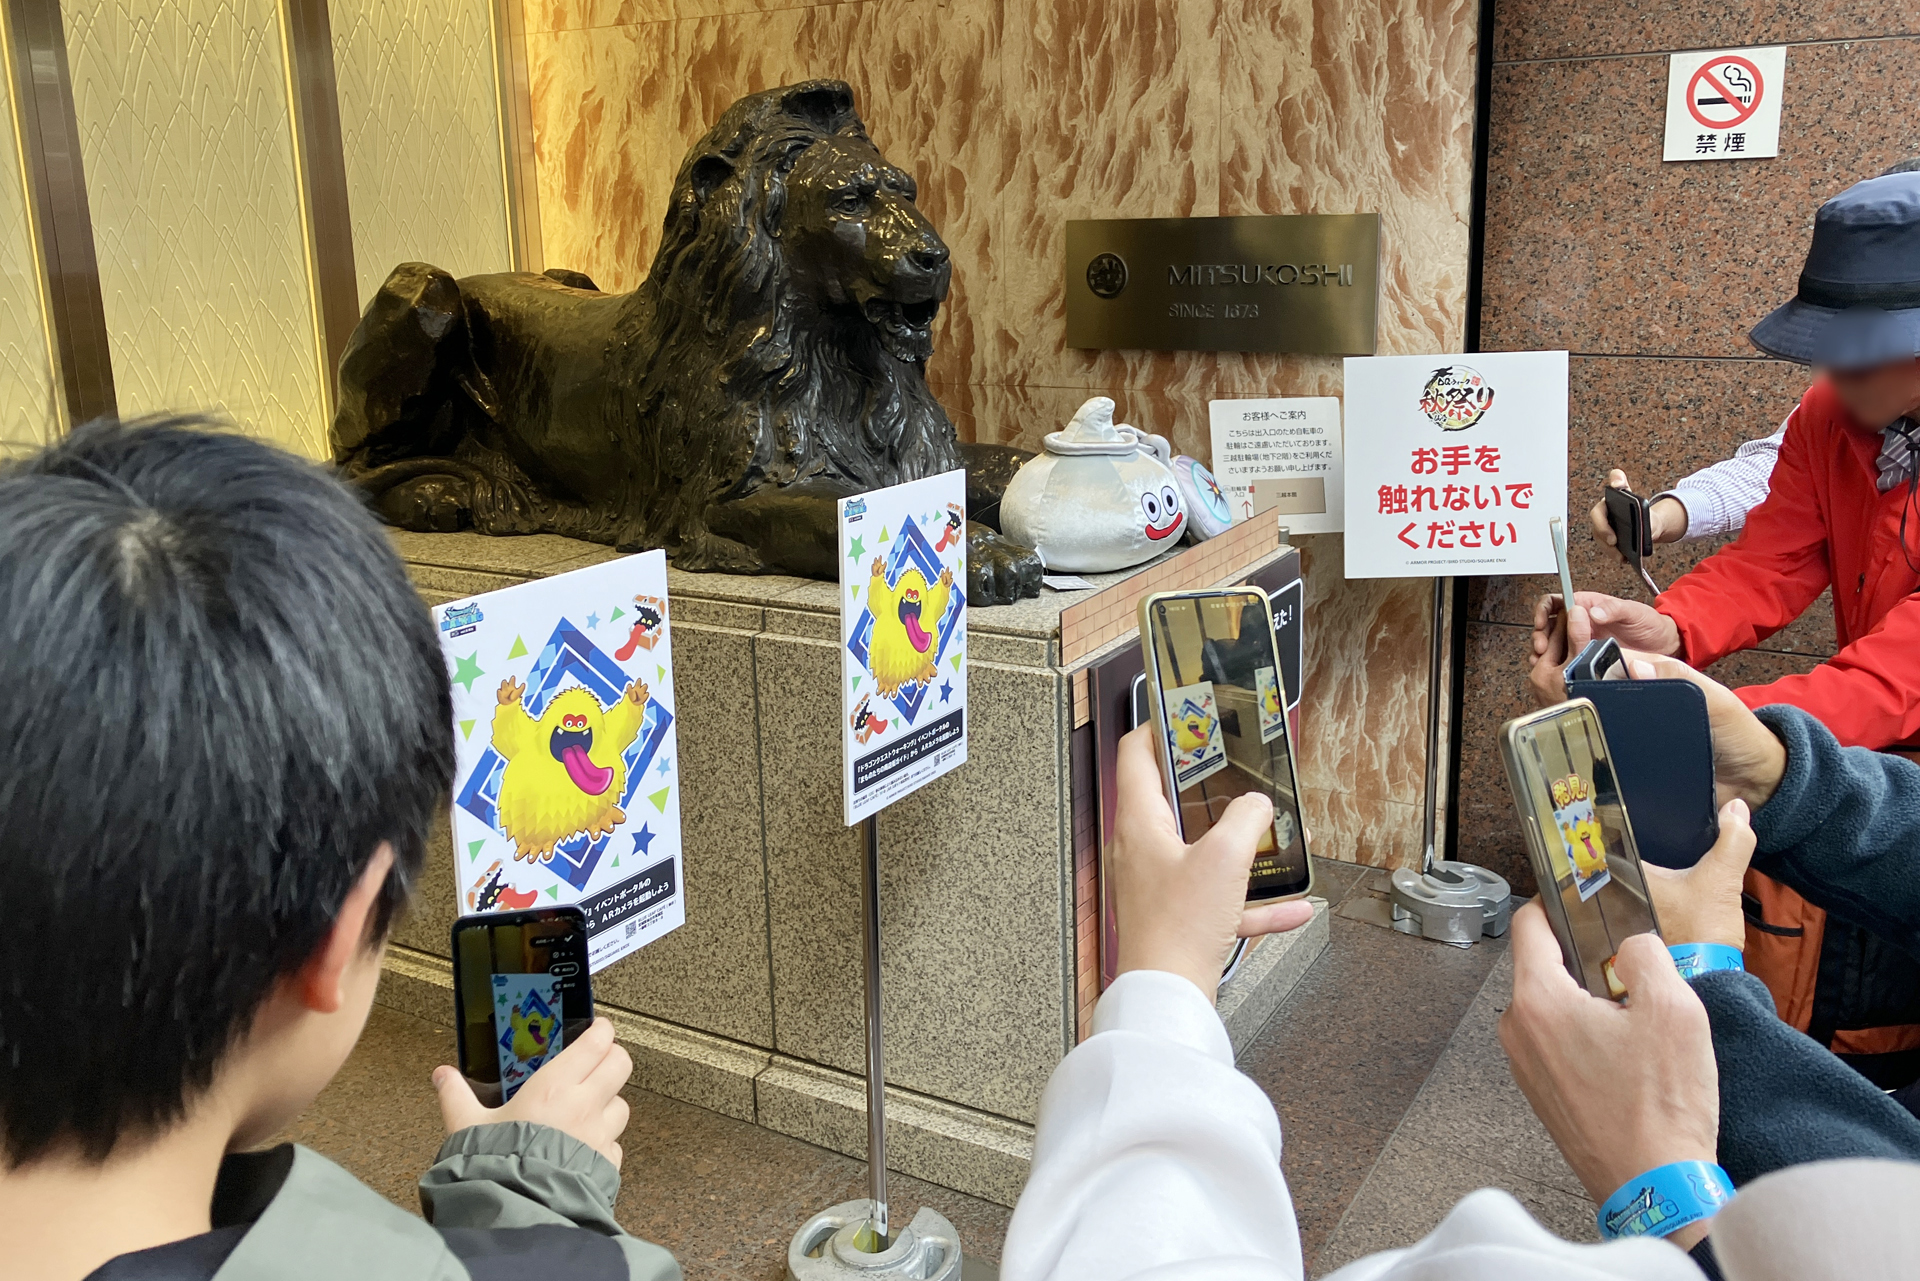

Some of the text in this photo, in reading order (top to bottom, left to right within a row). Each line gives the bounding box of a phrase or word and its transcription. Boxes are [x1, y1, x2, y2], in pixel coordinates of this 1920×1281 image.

[1695, 132, 1746, 154] 禁煙
[1167, 263, 1353, 288] MITSUKOSHI
[1168, 303, 1259, 318] SINCE 1673
[1242, 410, 1307, 421] お客様へご案内
[1418, 386, 1495, 421] 秋祭り
[1226, 439, 1332, 450] 駐輪はご遠慮いただいております。
[1228, 427, 1324, 438] こちらは出入口のため自転車の
[1228, 463, 1331, 474] さいますようお願い申し上げます。
[1410, 445, 1501, 475] お手を
[1377, 483, 1534, 515] 触れないで
[1396, 520, 1518, 550] ください
[1552, 773, 1589, 810] 発見!
[601, 881, 670, 924] ARカメラを起動しよう
